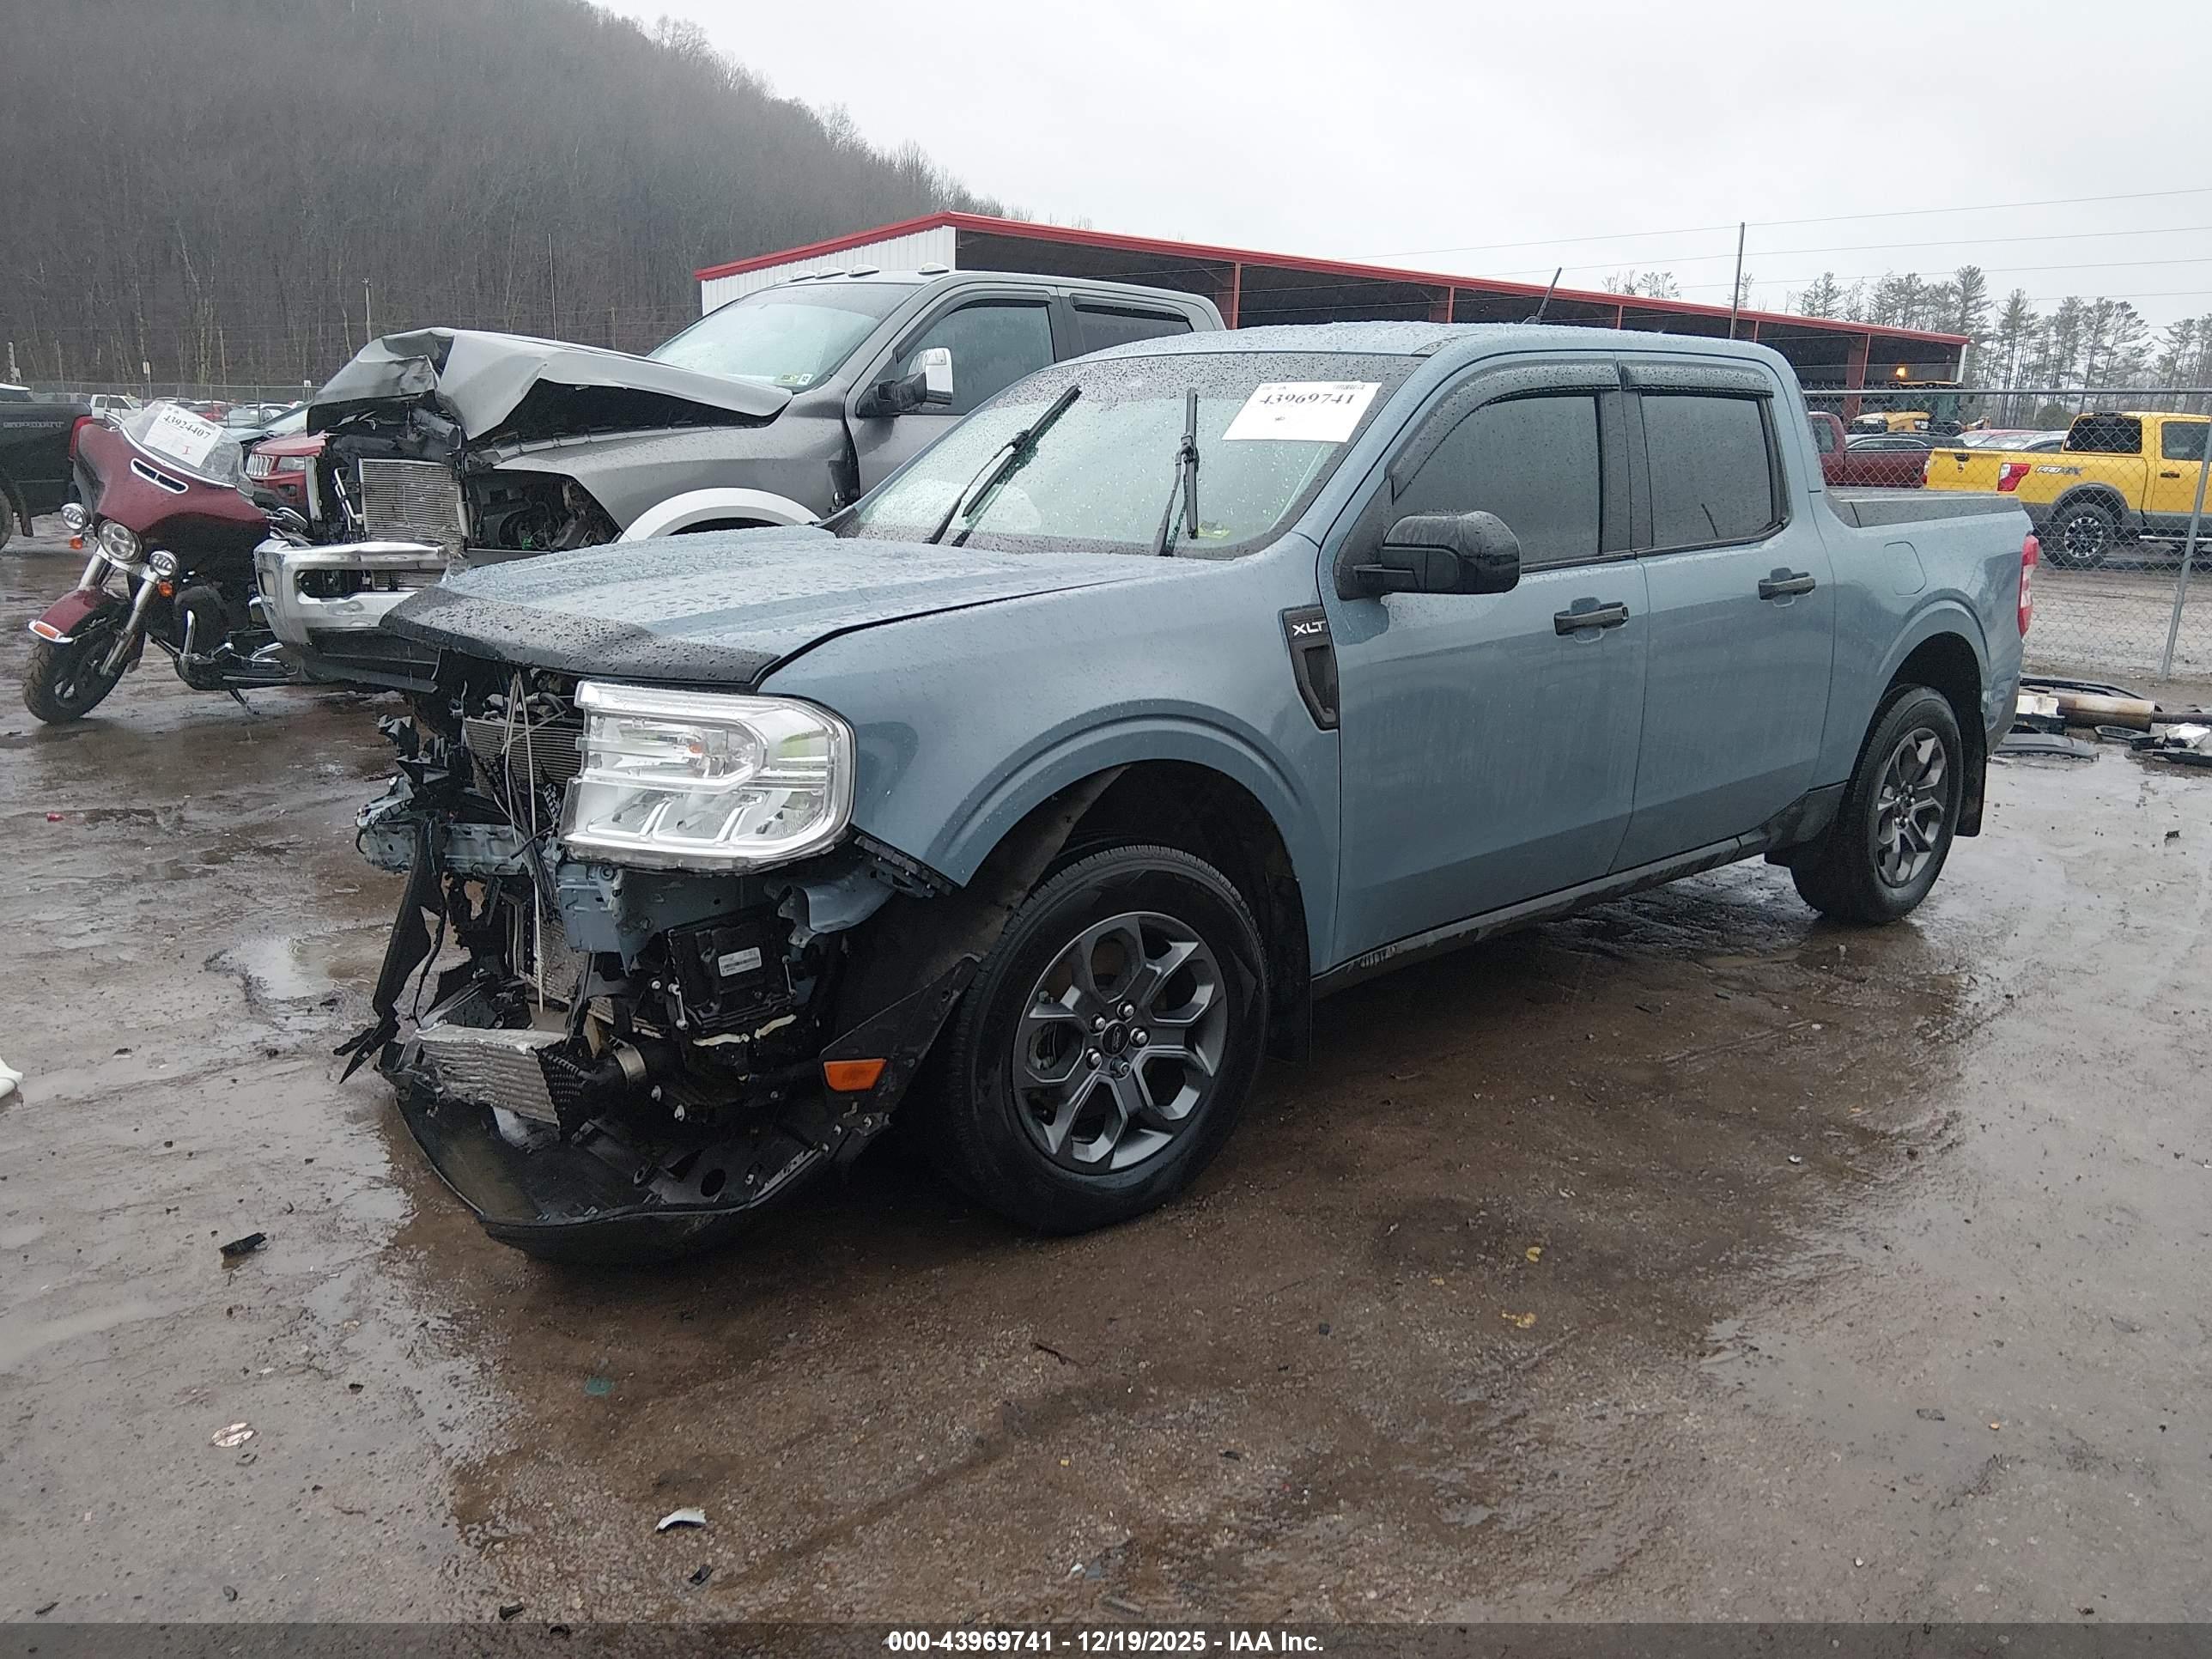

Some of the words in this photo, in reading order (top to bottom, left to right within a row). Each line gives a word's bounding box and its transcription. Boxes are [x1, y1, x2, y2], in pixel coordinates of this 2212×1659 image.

[1259, 392, 1355, 404] 43969741
[163, 415, 211, 440] 43924407
[1291, 620, 1327, 637] XLT
